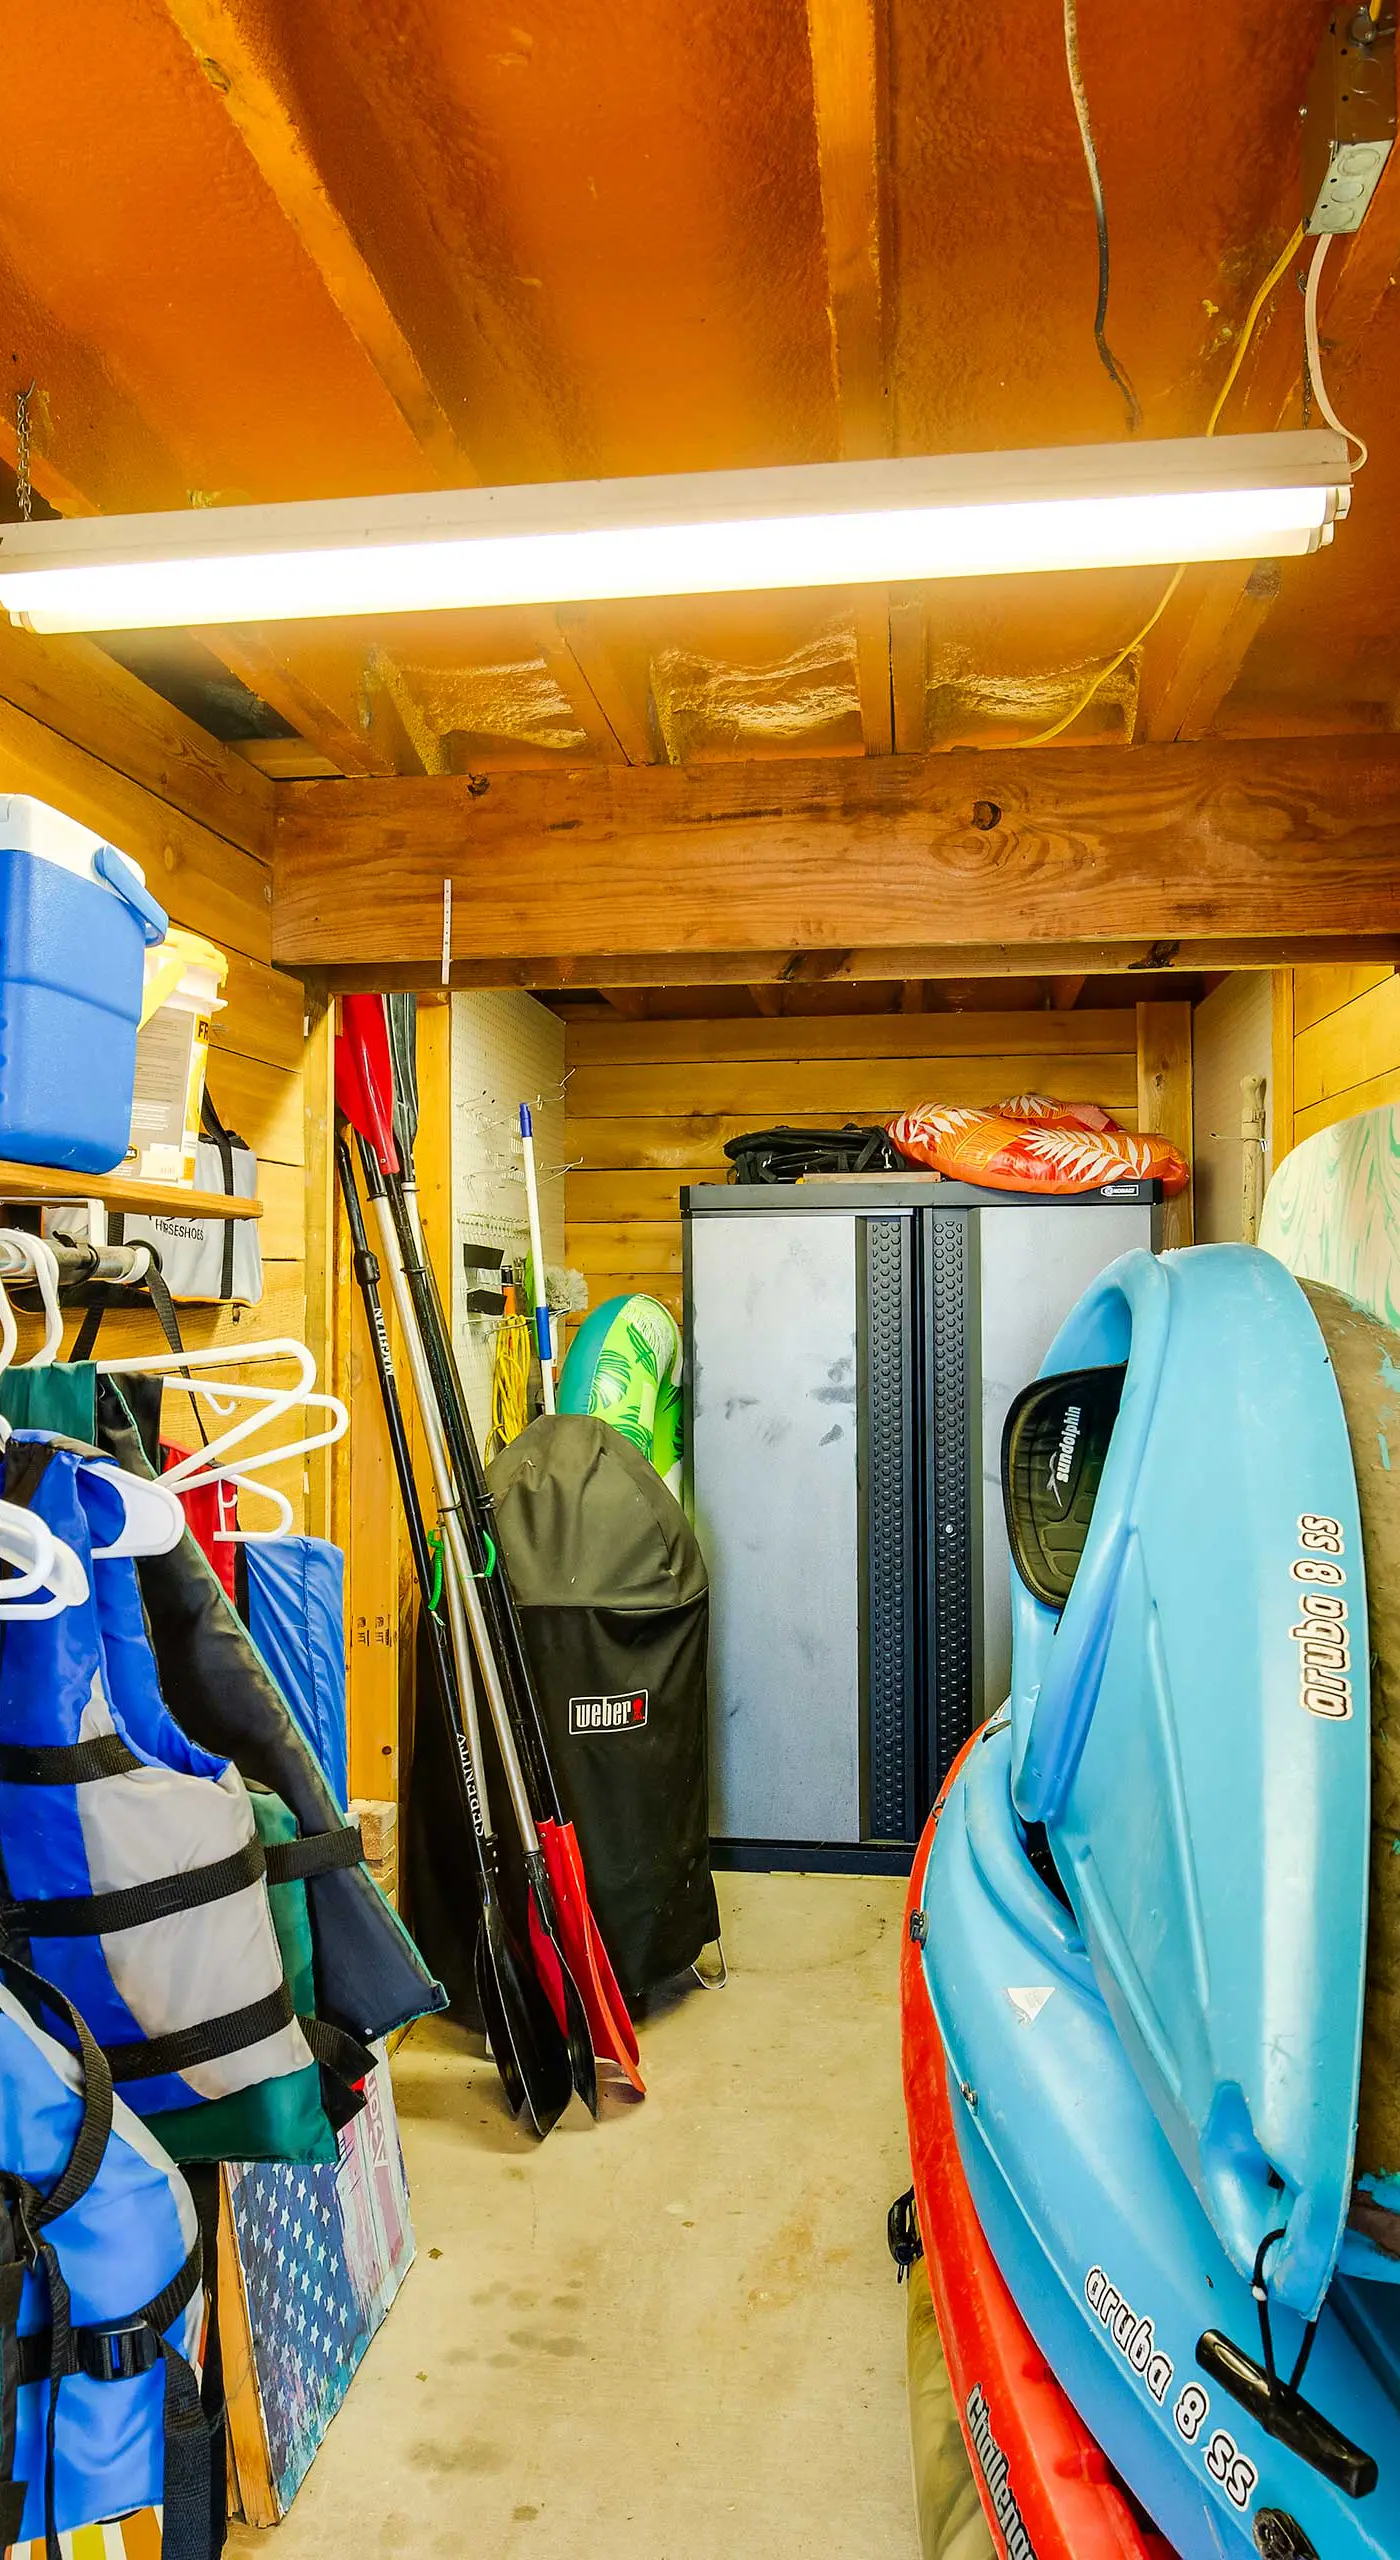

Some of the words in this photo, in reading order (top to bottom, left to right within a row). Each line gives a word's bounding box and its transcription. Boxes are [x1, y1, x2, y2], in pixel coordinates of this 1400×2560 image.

[155, 1218, 204, 1241] HRSESHOES
[1056, 1405, 1082, 1484] sundolphin
[1292, 1559, 1343, 1585] 8
[1291, 1593, 1348, 1718] aruba
[575, 1697, 632, 1728] weber
[1085, 2267, 1173, 2402] aruba
[1175, 2386, 1207, 2441] 8
[966, 2383, 1039, 2560] Challeng
